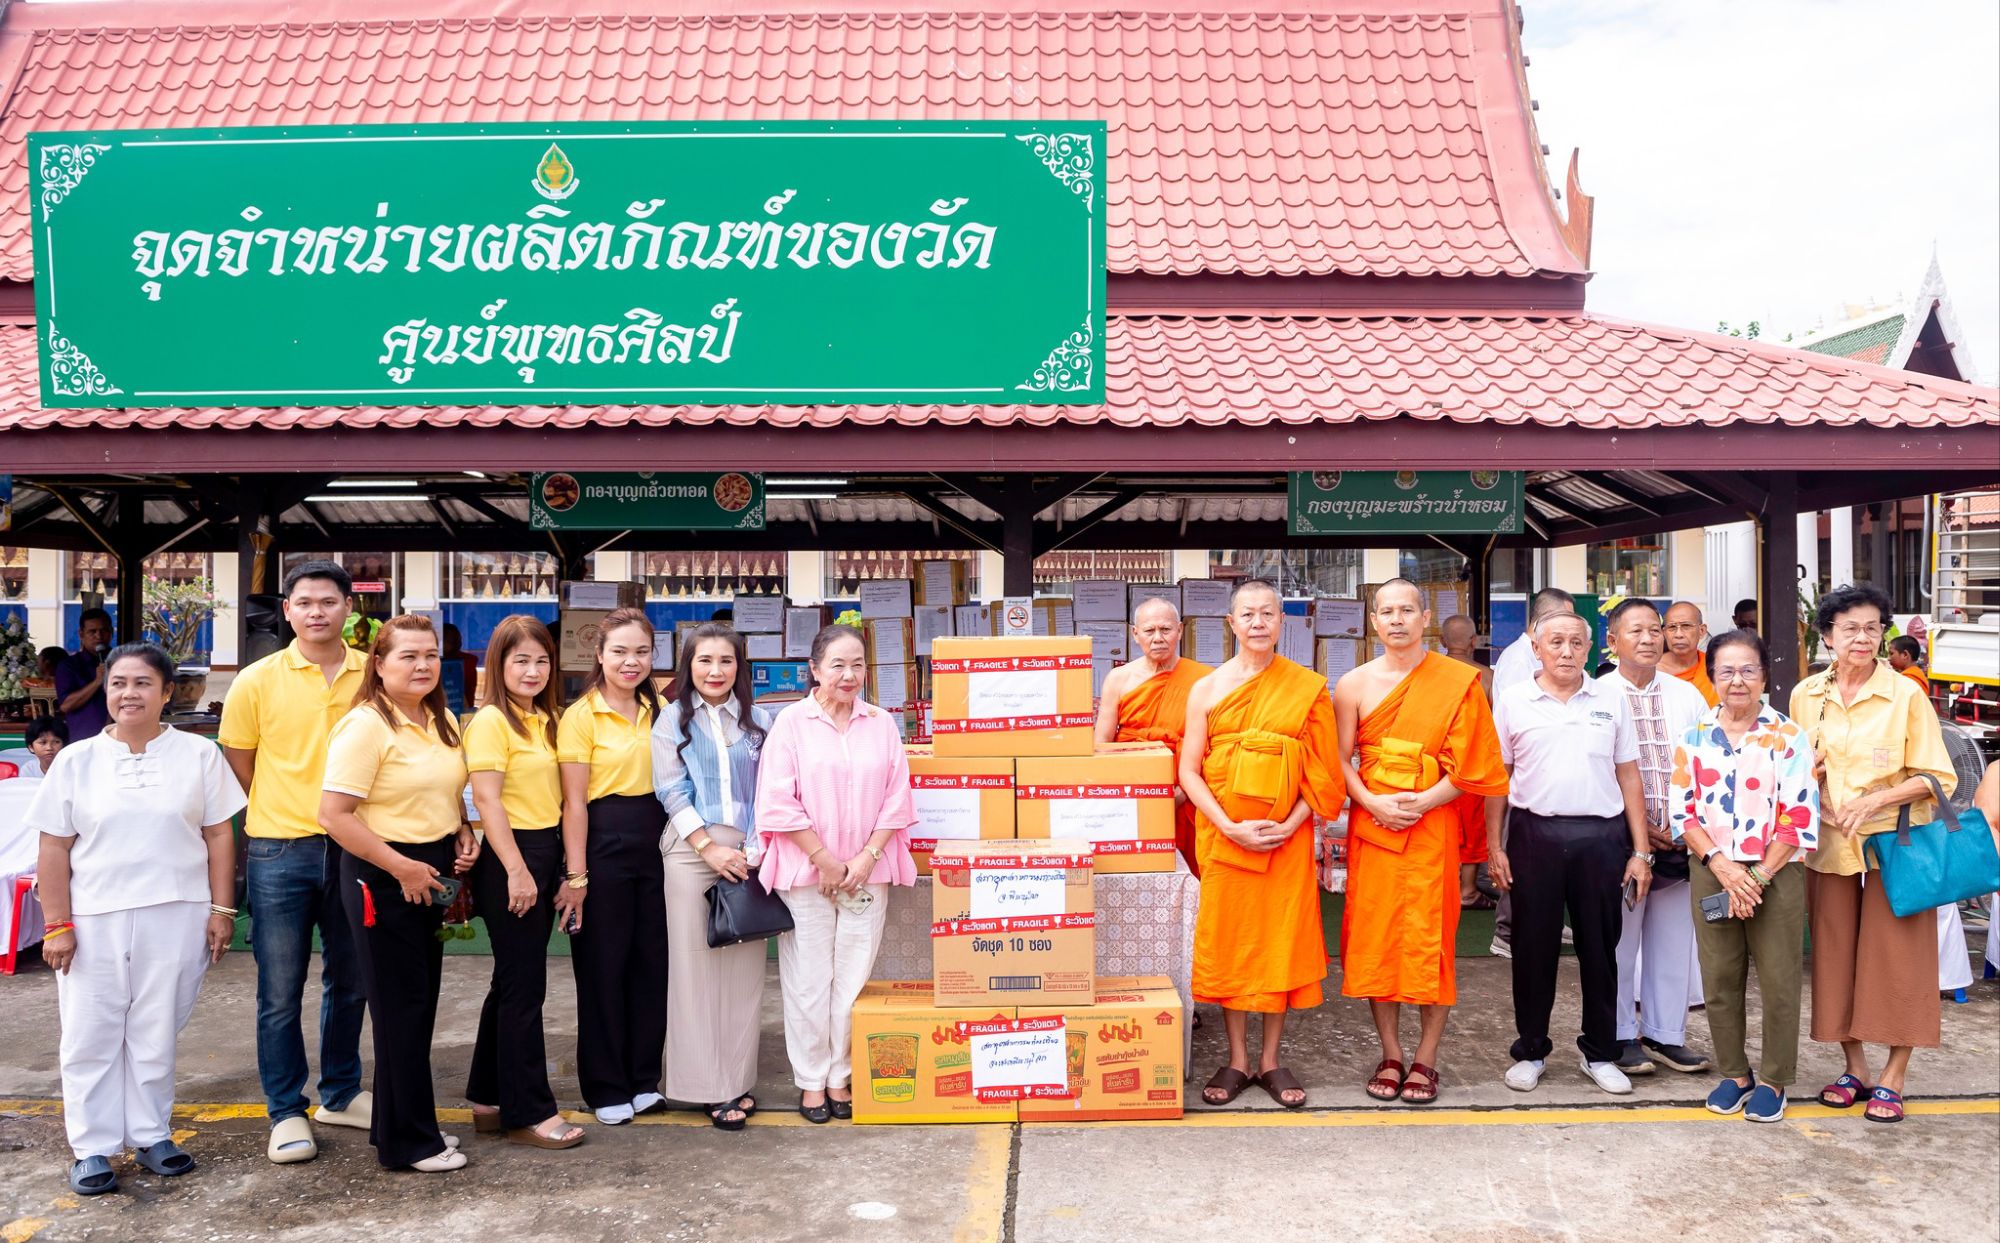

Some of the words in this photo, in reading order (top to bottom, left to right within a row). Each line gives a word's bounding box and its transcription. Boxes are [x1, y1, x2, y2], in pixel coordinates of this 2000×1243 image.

[131, 189, 997, 301] จุดจำหน่ายผลิตภัณฑ์ของวัด
[379, 298, 742, 383] ศูนย์พุทธศิลป์
[585, 481, 707, 503] กองบุญกล้วยทอด
[1307, 489, 1507, 520] กองบุญมะพร้าวน้ำหอม
[974, 661, 1008, 669] FRAGILE
[1023, 658, 1055, 668] ระวังแตก
[970, 721, 1004, 730] FRAGILE
[1019, 717, 1051, 728] ระวังแตก
[924, 776, 957, 787] ระวังแตก
[971, 778, 1005, 786] FRAGILE
[1039, 788, 1073, 797] FRAGILE
[1088, 786, 1120, 797] ระวังแตก
[1134, 787, 1168, 796] FRAGILE
[1100, 842, 1131, 853] ระวังแตก
[929, 856, 963, 867] ระวังแตก
[979, 858, 1016, 866] FRAGILE
[1032, 856, 1066, 867] ระวังแตก
[962, 922, 997, 932] ระวังแตก
[1013, 920, 1050, 929] FRAGILE
[972, 937, 1004, 957] จัดชุด
[1009, 938, 1024, 951] 10
[1029, 938, 1052, 951] ซอง
[970, 1024, 1008, 1032] FRAGILE
[1023, 1019, 1058, 1030] ระวังแตก
[982, 1089, 1019, 1098] FRAGILE
[1035, 1085, 1070, 1096] ระวังแตก
